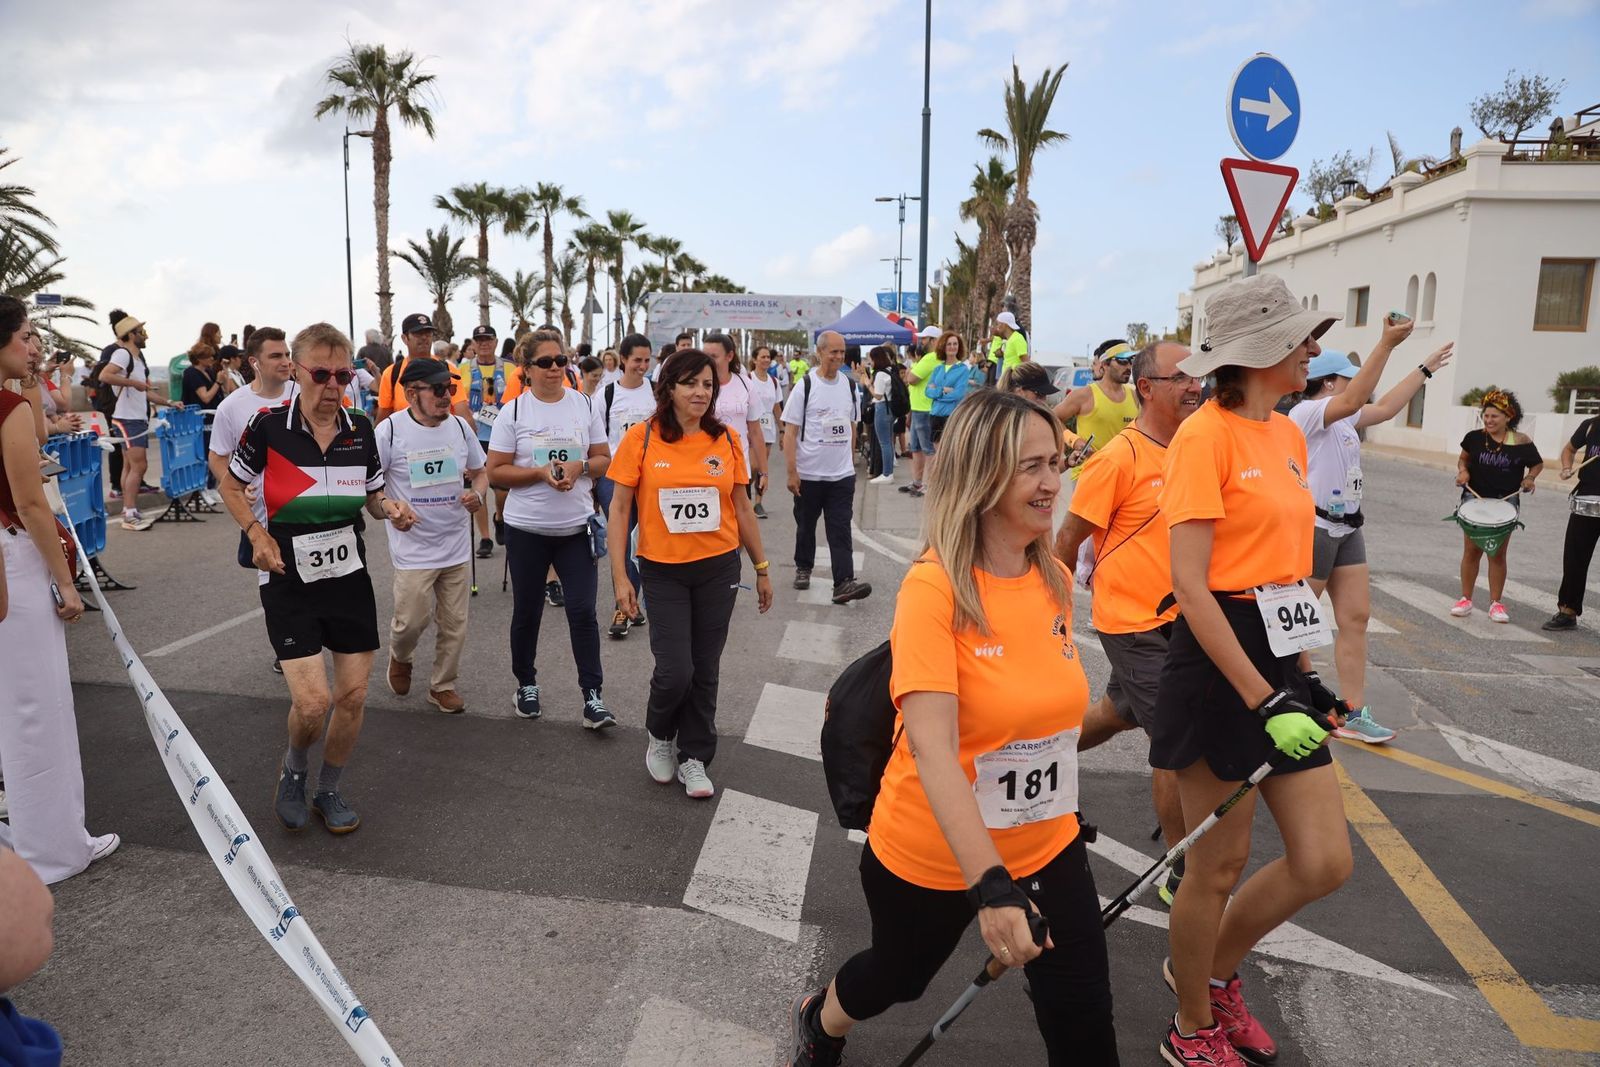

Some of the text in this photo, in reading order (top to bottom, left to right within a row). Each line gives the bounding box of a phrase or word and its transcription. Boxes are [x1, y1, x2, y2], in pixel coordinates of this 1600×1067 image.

[722, 299, 765, 308] CARRERA
[767, 300, 779, 308] 5K
[844, 332, 895, 340] @dorsalchip.es
[832, 425, 845, 435] 58
[548, 449, 568, 462] 66
[424, 460, 444, 475] 67
[671, 503, 709, 520] 703
[308, 544, 348, 567] 310
[1277, 602, 1320, 631] 942
[998, 761, 1058, 801] 181
[315, 964, 322, 976] de
[320, 972, 348, 1015] Ayuntamiento
